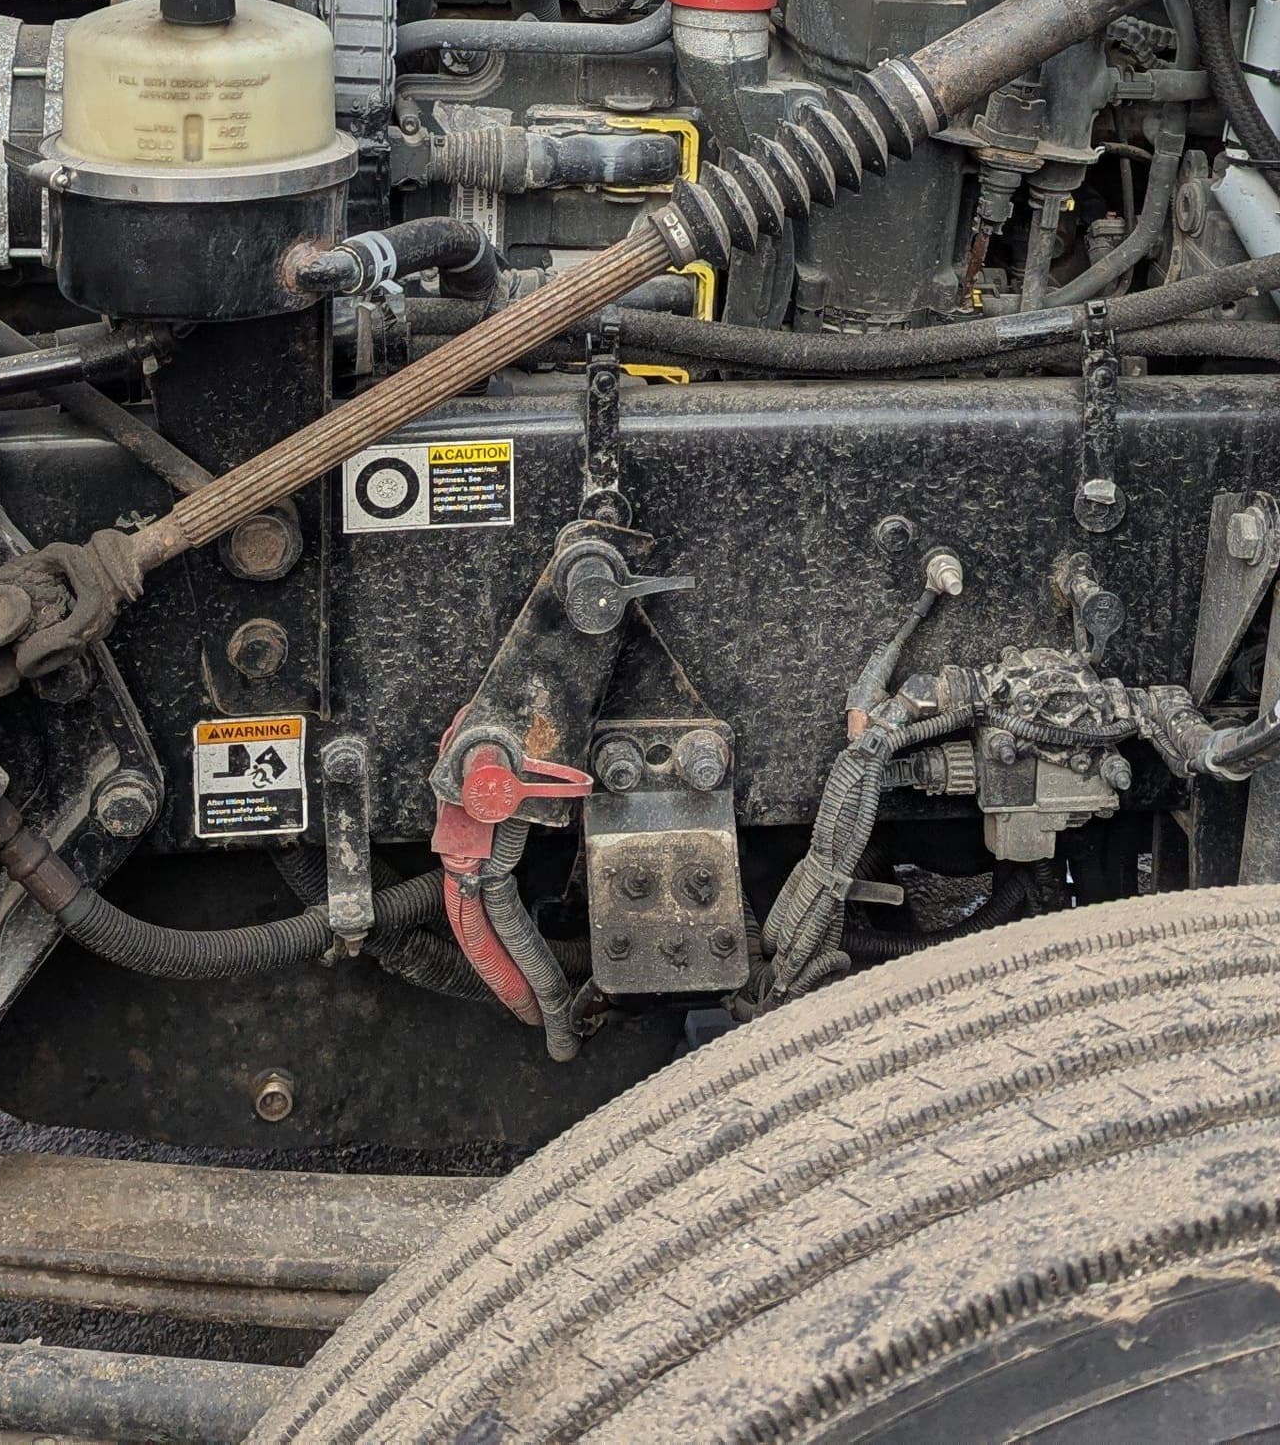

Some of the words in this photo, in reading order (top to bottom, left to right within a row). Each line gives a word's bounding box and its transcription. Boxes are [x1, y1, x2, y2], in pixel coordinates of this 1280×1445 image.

[118, 75, 138, 87] FILL
[144, 77, 166, 88] WITH
[139, 92, 191, 101] APPROVED
[230, 112, 252, 120] FULL
[154, 125, 176, 134] FULL
[218, 126, 247, 137] HOT
[137, 139, 174, 151] COLD
[445, 447, 508, 460] CAUTION
[433, 477, 467, 485] tightness.
[433, 486, 468, 494] operator's
[220, 724, 291, 738] WARNING
[207, 799, 224, 807] After
[225, 798, 245, 806] tilting
[232, 806, 253, 814] safety
[255, 805, 278, 813] device
[216, 816, 242, 825] prevent
[244, 815, 271, 823] closing.
